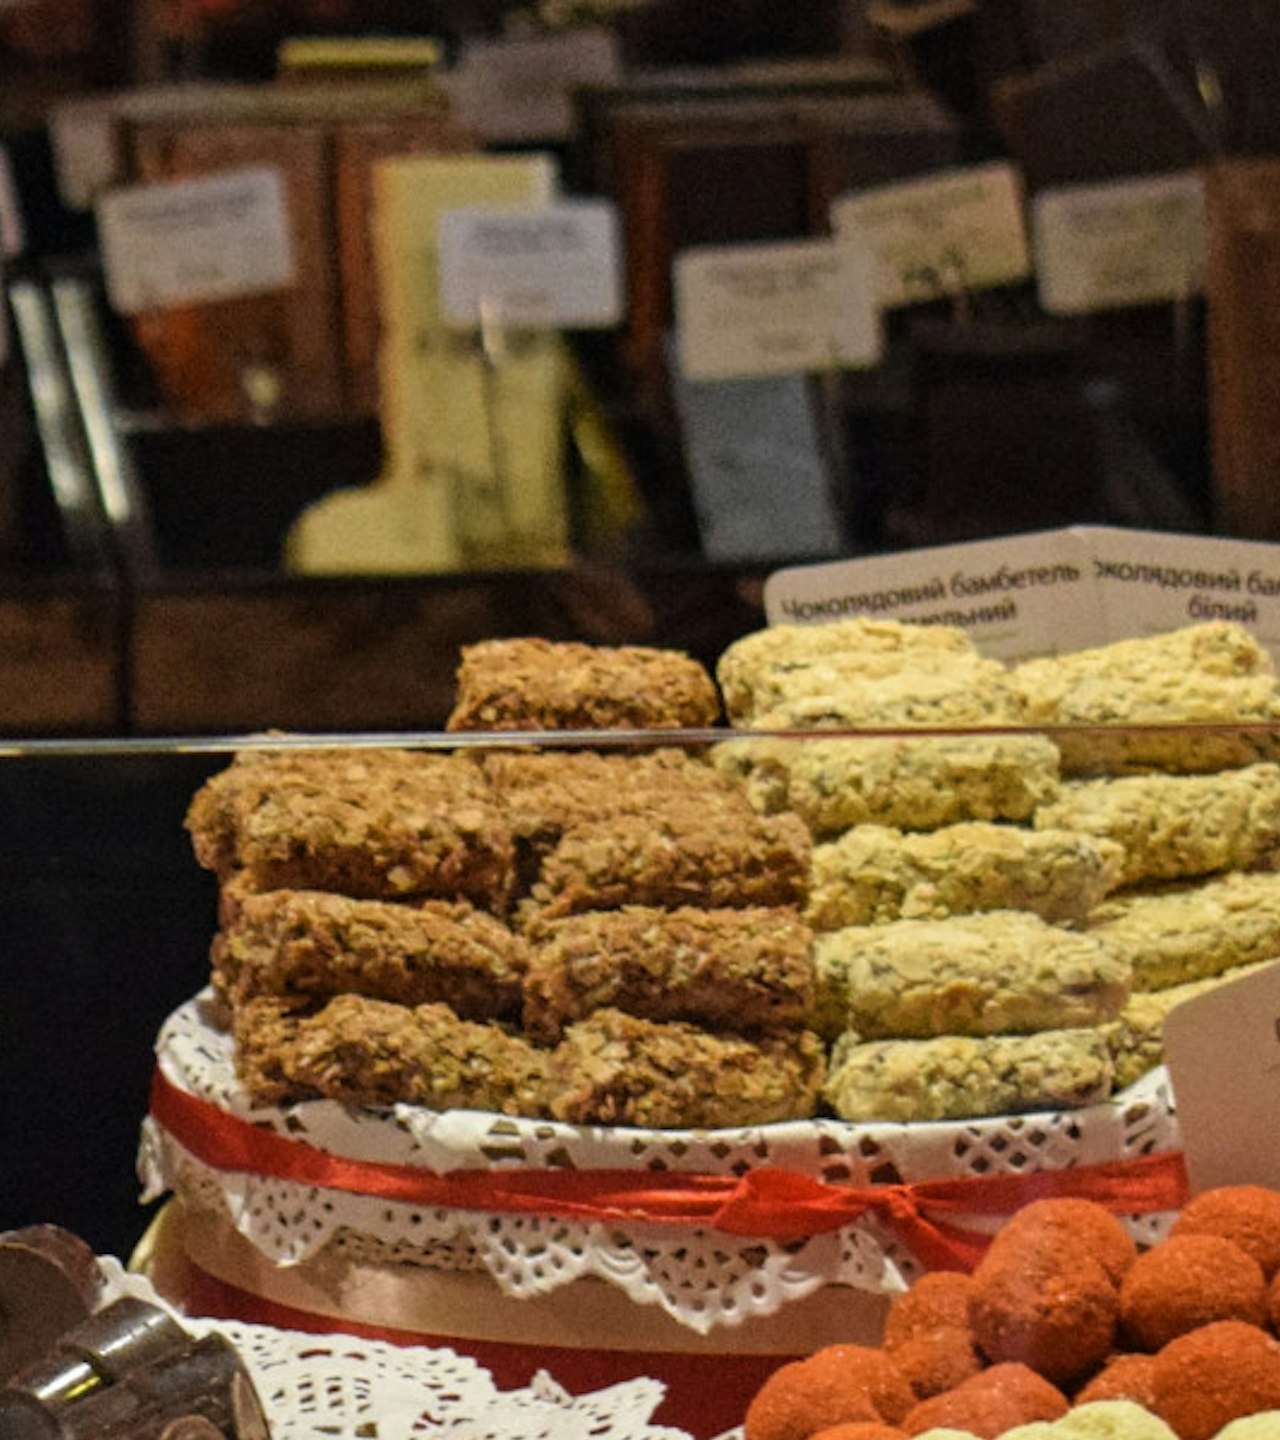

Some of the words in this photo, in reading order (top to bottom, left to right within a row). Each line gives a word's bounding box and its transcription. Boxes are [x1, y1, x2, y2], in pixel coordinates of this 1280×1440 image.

[781, 577, 946, 621] Чоколядовий
[950, 563, 1080, 598] бамбетель
[1186, 594, 1257, 622] білий
